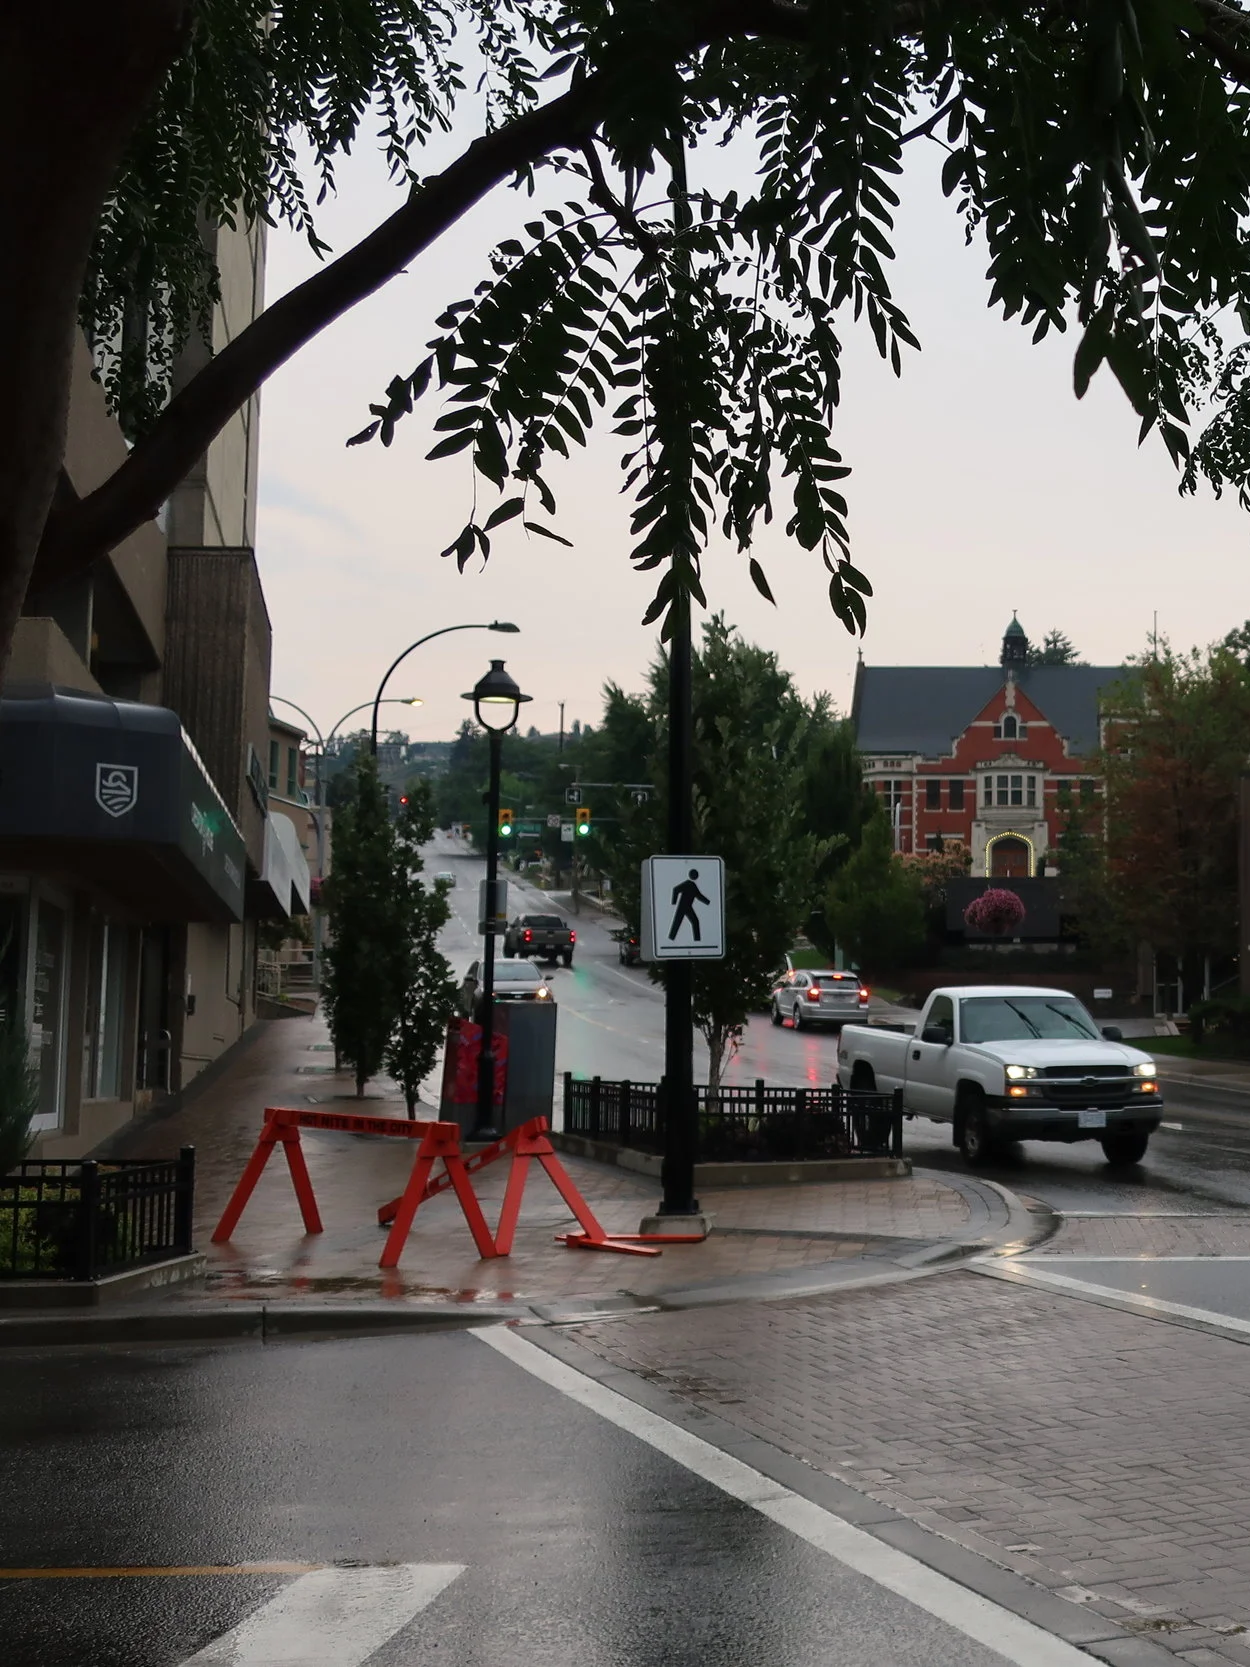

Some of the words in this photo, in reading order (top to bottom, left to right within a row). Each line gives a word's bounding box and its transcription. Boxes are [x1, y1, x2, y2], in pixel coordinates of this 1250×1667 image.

[321, 1116, 348, 1128] NITE
[354, 1119, 364, 1129] IN
[368, 1120, 386, 1131] THE
[390, 1122, 413, 1134] CITY
